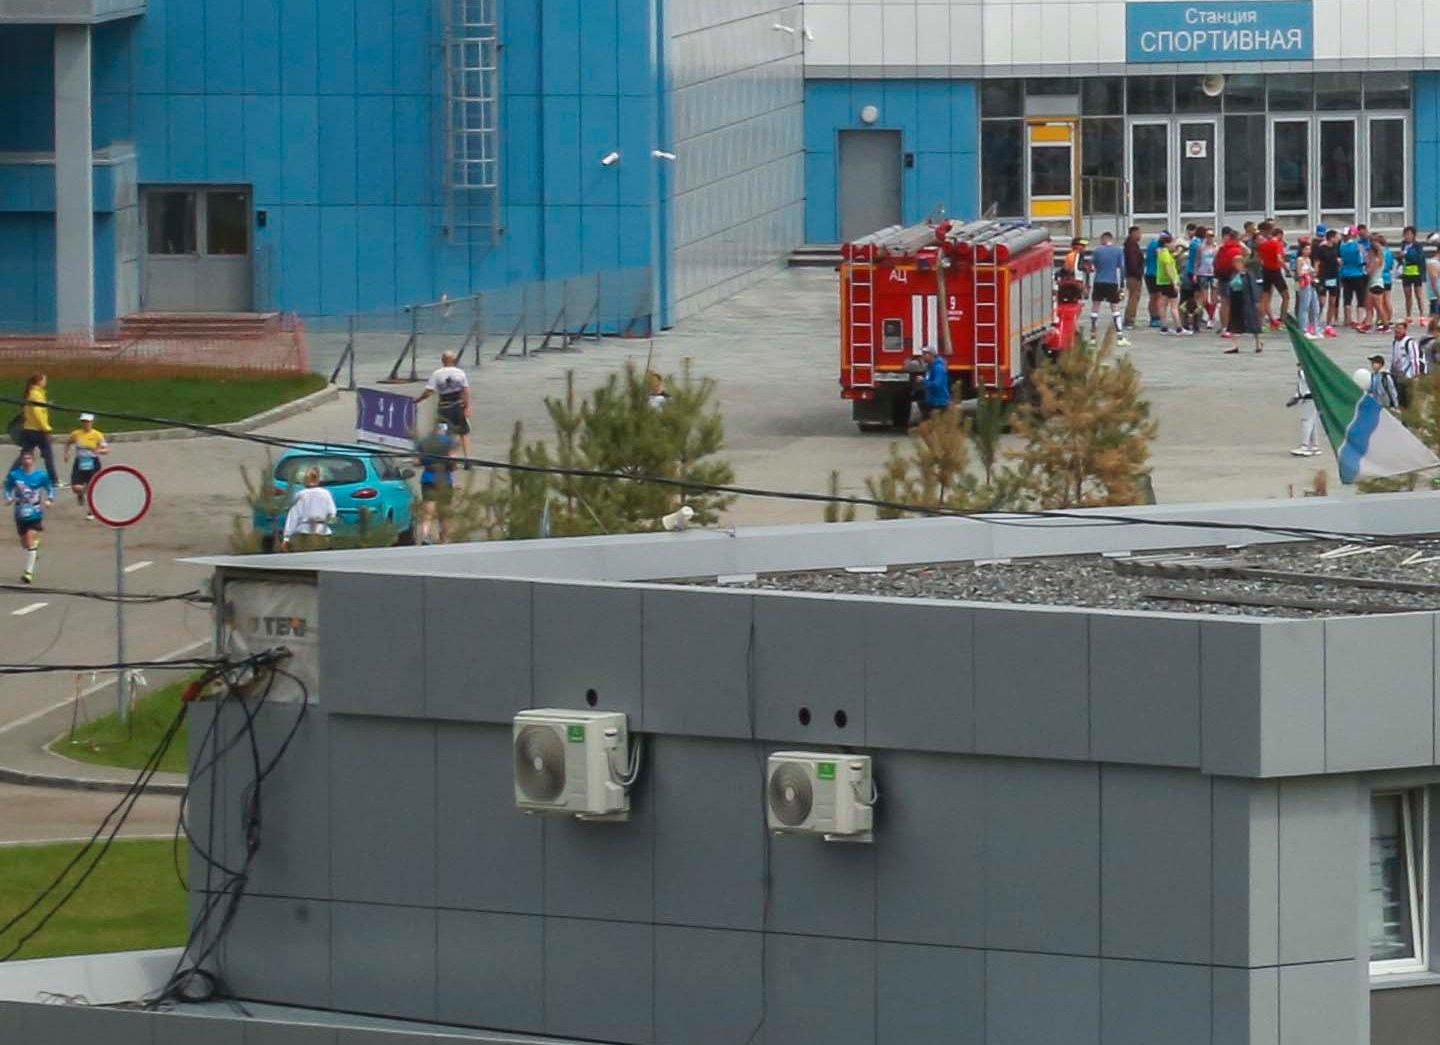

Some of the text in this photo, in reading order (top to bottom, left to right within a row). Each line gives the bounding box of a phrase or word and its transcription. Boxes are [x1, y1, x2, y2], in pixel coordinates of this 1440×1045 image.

[1184, 7, 1258, 25] Станция
[1140, 28, 1303, 53] СПОРТИВНАЯ
[889, 269, 907, 284] АЦ
